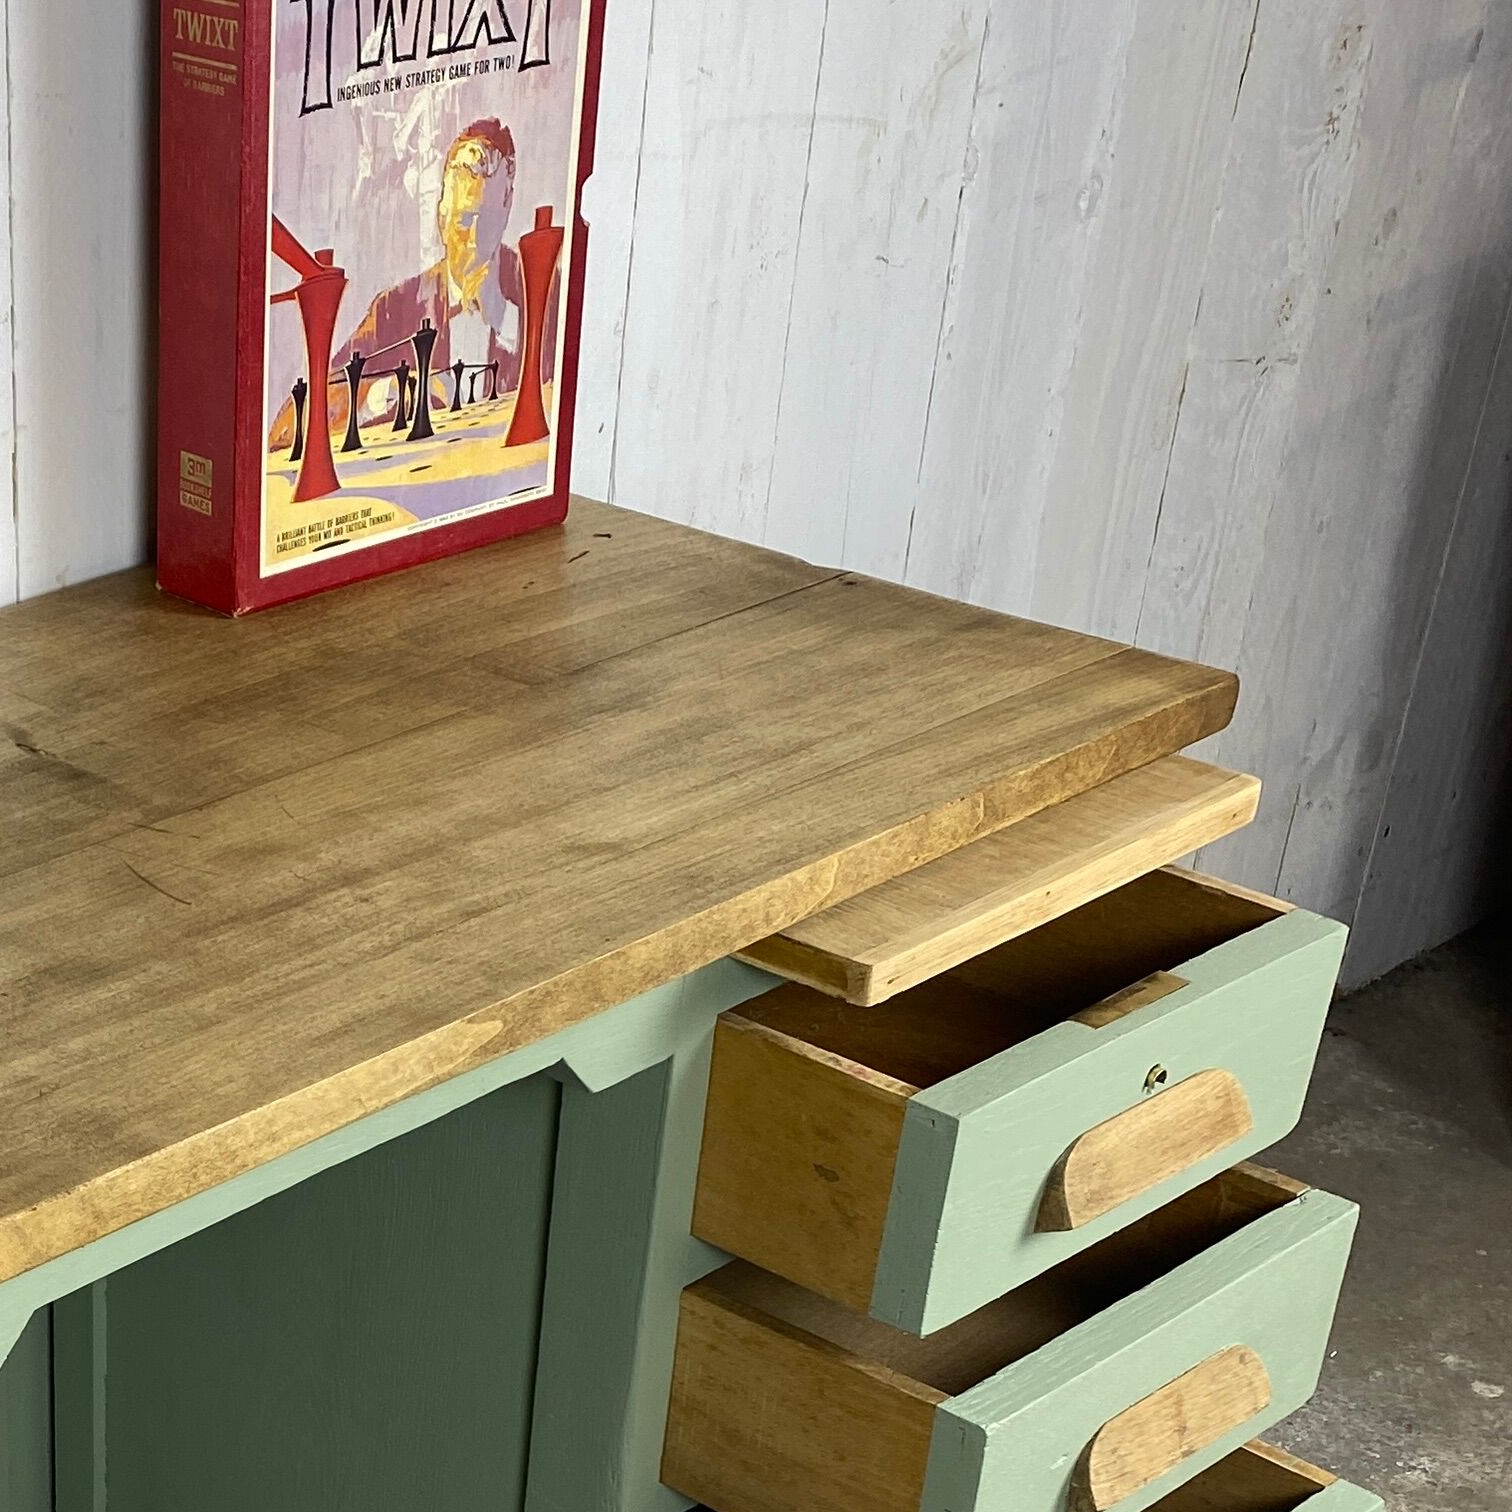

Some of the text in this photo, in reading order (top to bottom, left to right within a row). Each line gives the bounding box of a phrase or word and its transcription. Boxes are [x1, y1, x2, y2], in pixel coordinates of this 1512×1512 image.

[173, 7, 239, 51] TWIXT
[337, 55, 516, 103] INGENIOUS NEW STRATEGY GAME FOR TWO!
[182, 492, 210, 514] GAMES
[276, 508, 372, 543] A BRILLIANT BATTLE OF BARRIERS THAT
[276, 537, 307, 554] CHALLENGES
[308, 532, 322, 544] YOUR
[323, 530, 332, 540] WIT
[334, 526, 344, 538] AND
[345, 521, 367, 534] TACTICAL
